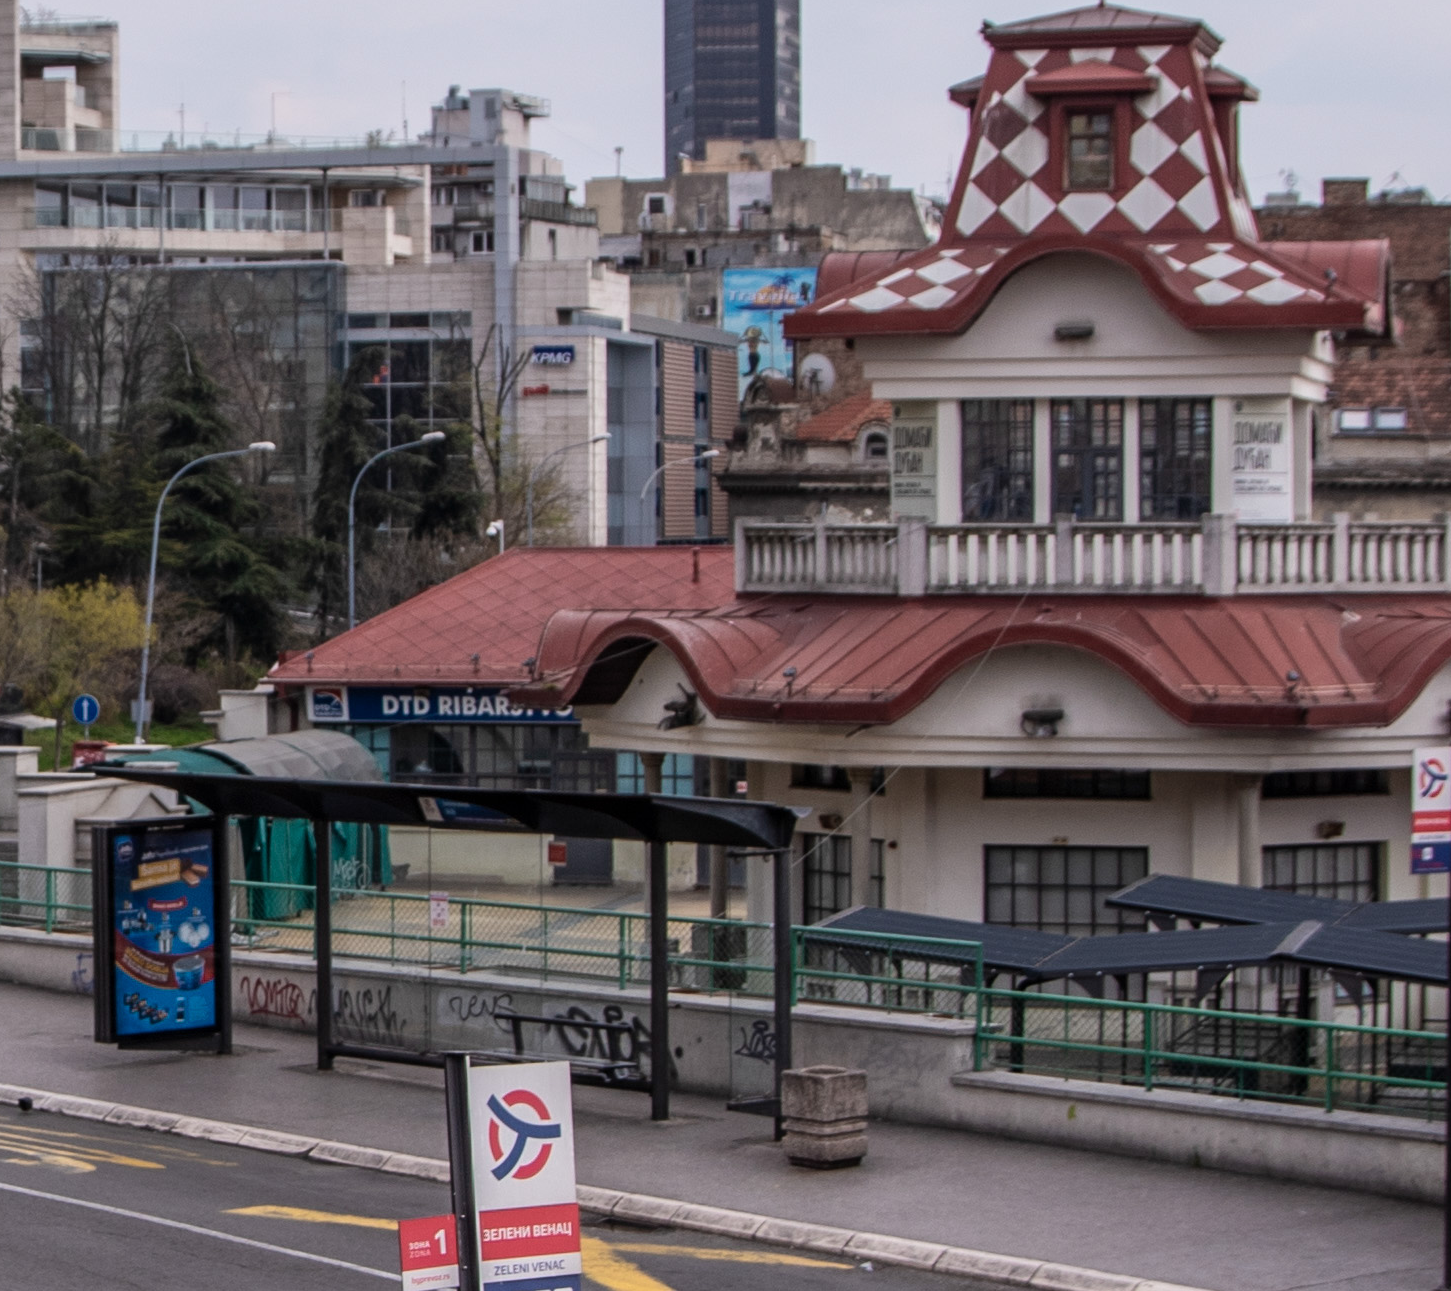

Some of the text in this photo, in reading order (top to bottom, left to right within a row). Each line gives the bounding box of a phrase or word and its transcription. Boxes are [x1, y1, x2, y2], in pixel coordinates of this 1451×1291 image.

[531, 352, 571, 364] KPMG
[382, 694, 573, 717] DTD RIBAR
[483, 1221, 573, 1242] ЗЕЛЕНИ ВЕНАЦ
[409, 1240, 431, 1250] ЗОНА
[434, 1228, 447, 1255] 1
[409, 1249, 431, 1258] ZONA
[494, 1260, 566, 1276] ZELENI VENAC
[411, 1273, 451, 1285] bgprevoz.rs
